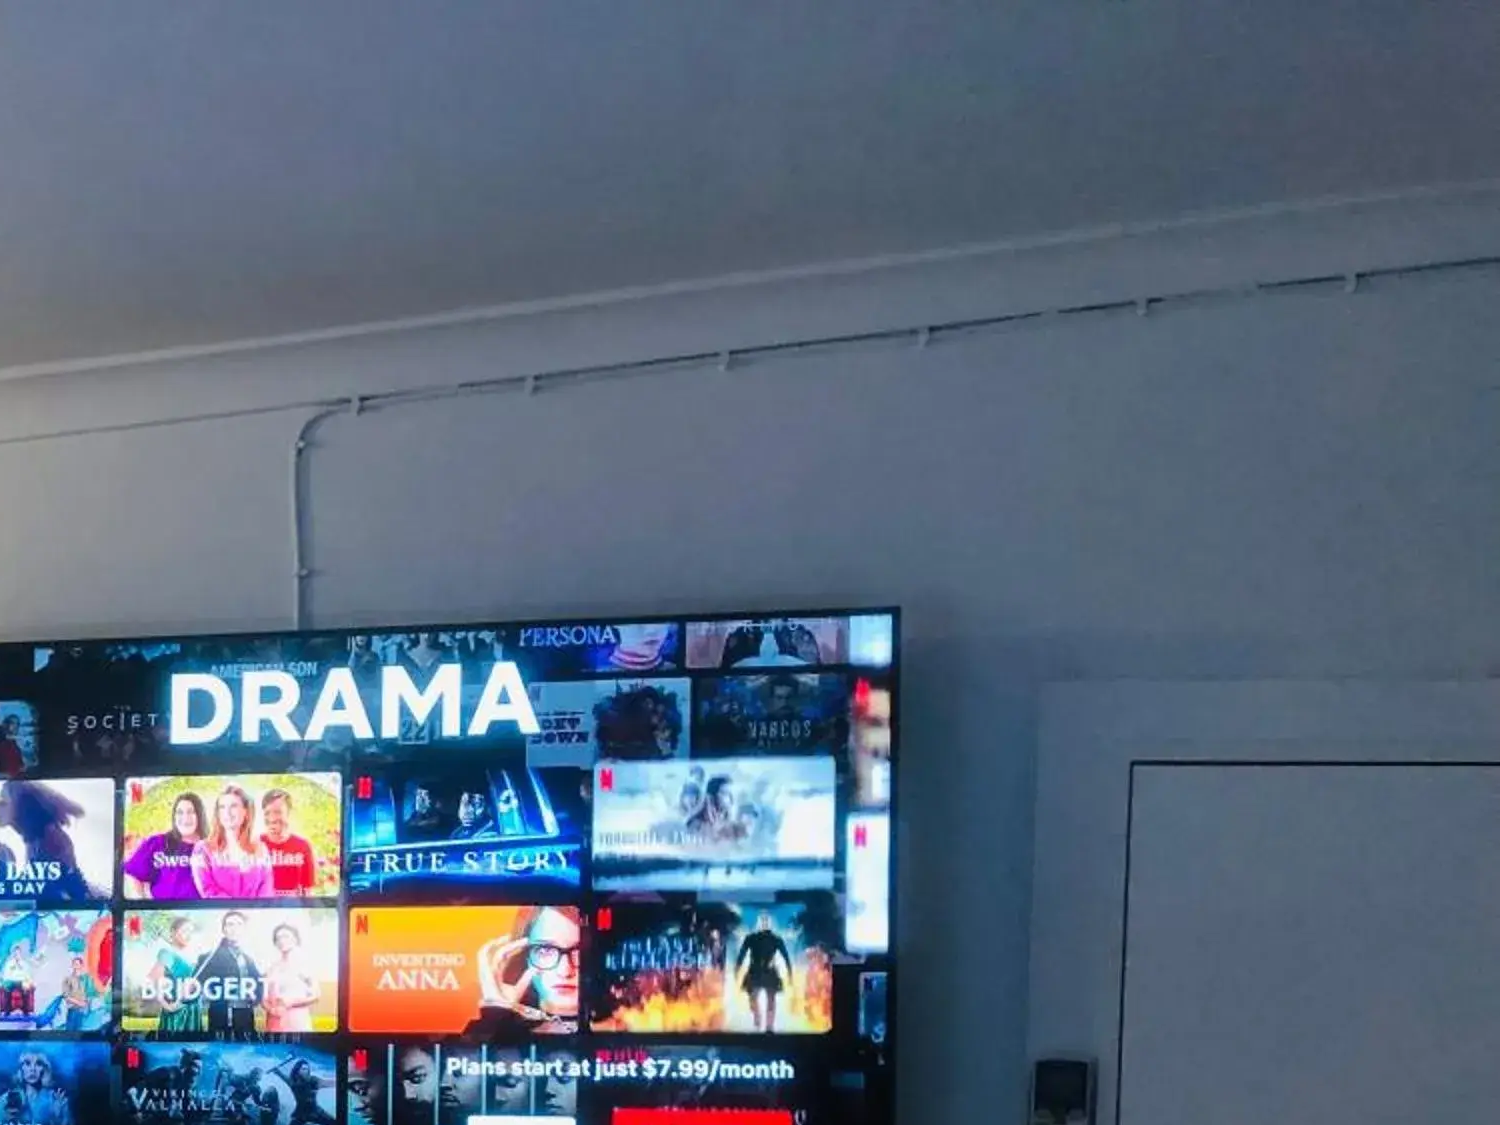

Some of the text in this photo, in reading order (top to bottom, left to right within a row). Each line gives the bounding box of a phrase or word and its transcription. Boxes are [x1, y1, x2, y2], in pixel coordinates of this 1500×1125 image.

[519, 624, 617, 647] PERSONA
[169, 661, 541, 745] DRAMA
[67, 712, 162, 734] SOCIET
[4, 860, 62, 881] DAYS
[362, 850, 569, 873] TRUE STORY
[12, 882, 48, 896] DAY
[373, 953, 465, 968] INVENTING
[141, 976, 272, 1001] BRIDGERT
[377, 969, 461, 992] ANNA
[447, 1057, 796, 1082] Plans start at just $7.99/month
